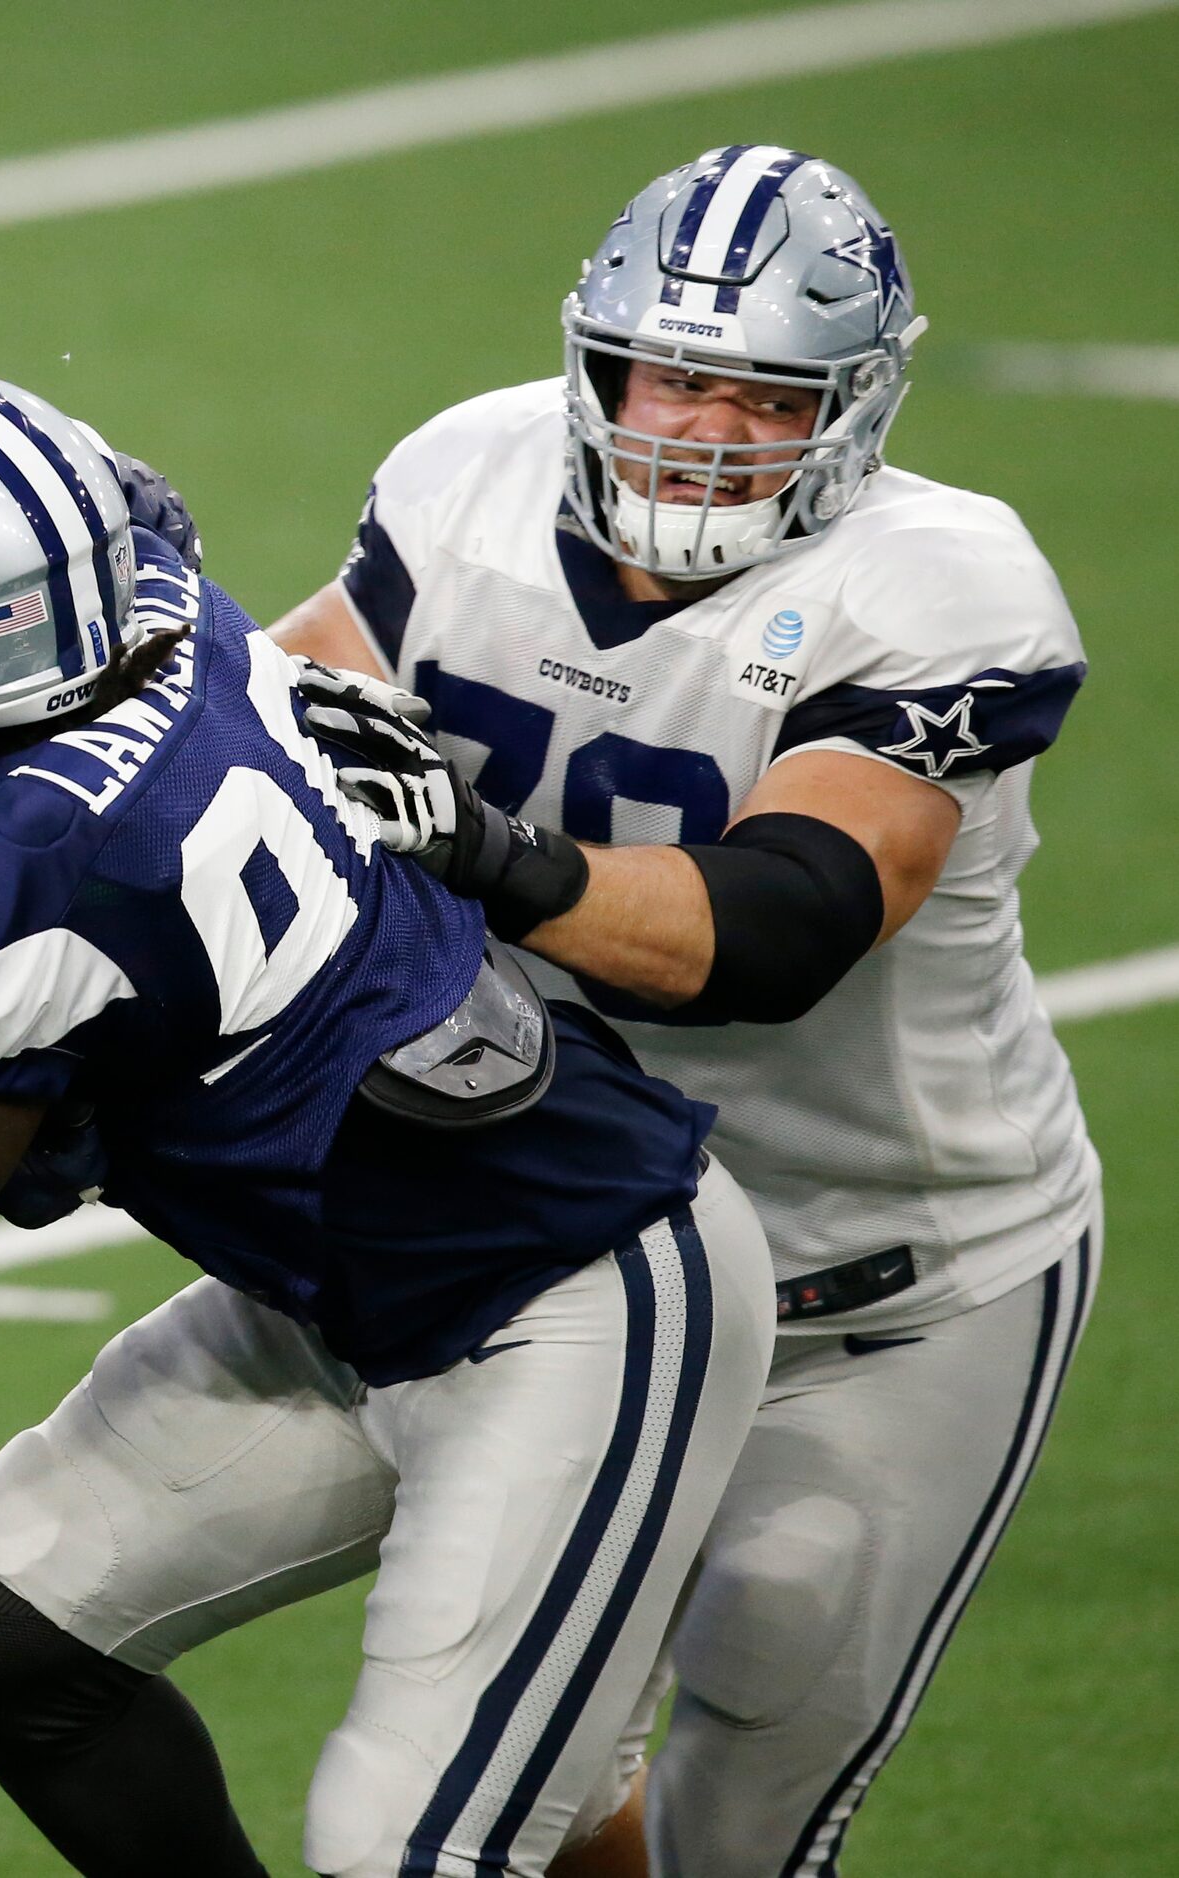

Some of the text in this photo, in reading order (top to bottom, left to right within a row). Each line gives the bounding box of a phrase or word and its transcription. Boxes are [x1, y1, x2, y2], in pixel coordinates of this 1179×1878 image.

[659, 318, 723, 338] COWBOYS
[539, 658, 632, 704] COWBOYS
[739, 662, 798, 697] AT&T
